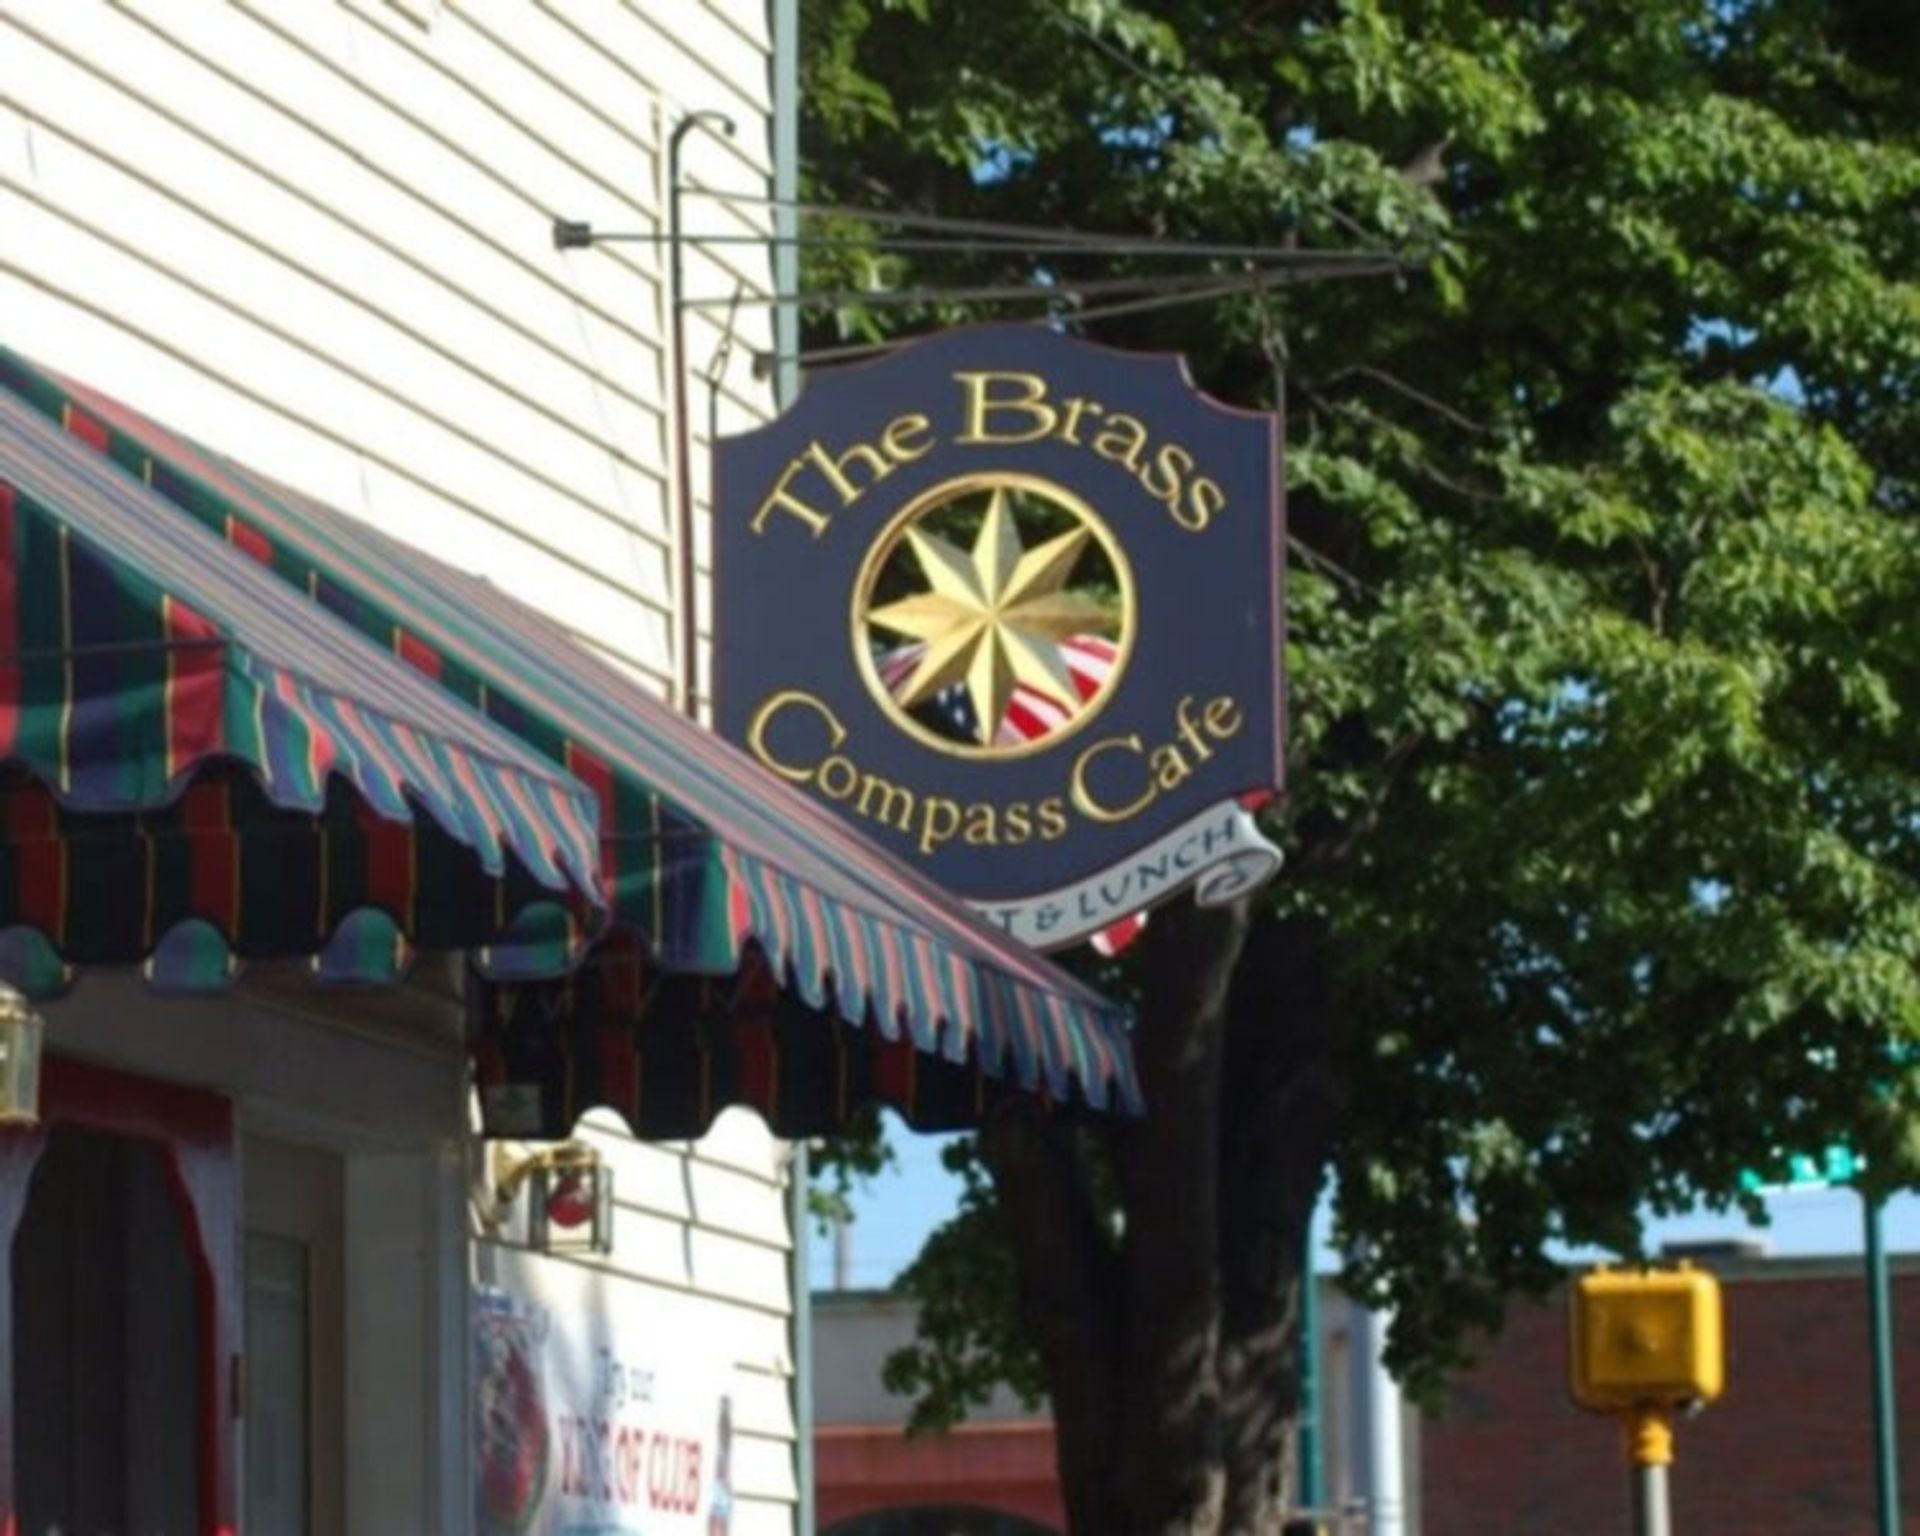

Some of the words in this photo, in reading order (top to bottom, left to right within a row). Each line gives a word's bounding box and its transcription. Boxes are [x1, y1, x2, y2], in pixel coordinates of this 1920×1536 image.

[750, 412, 937, 537] The
[952, 370, 1227, 533] Brass
[746, 689, 1067, 853] Compass
[1070, 694, 1244, 822] Cafe
[1035, 901, 1064, 932] &
[1078, 816, 1236, 919] LUNCH
